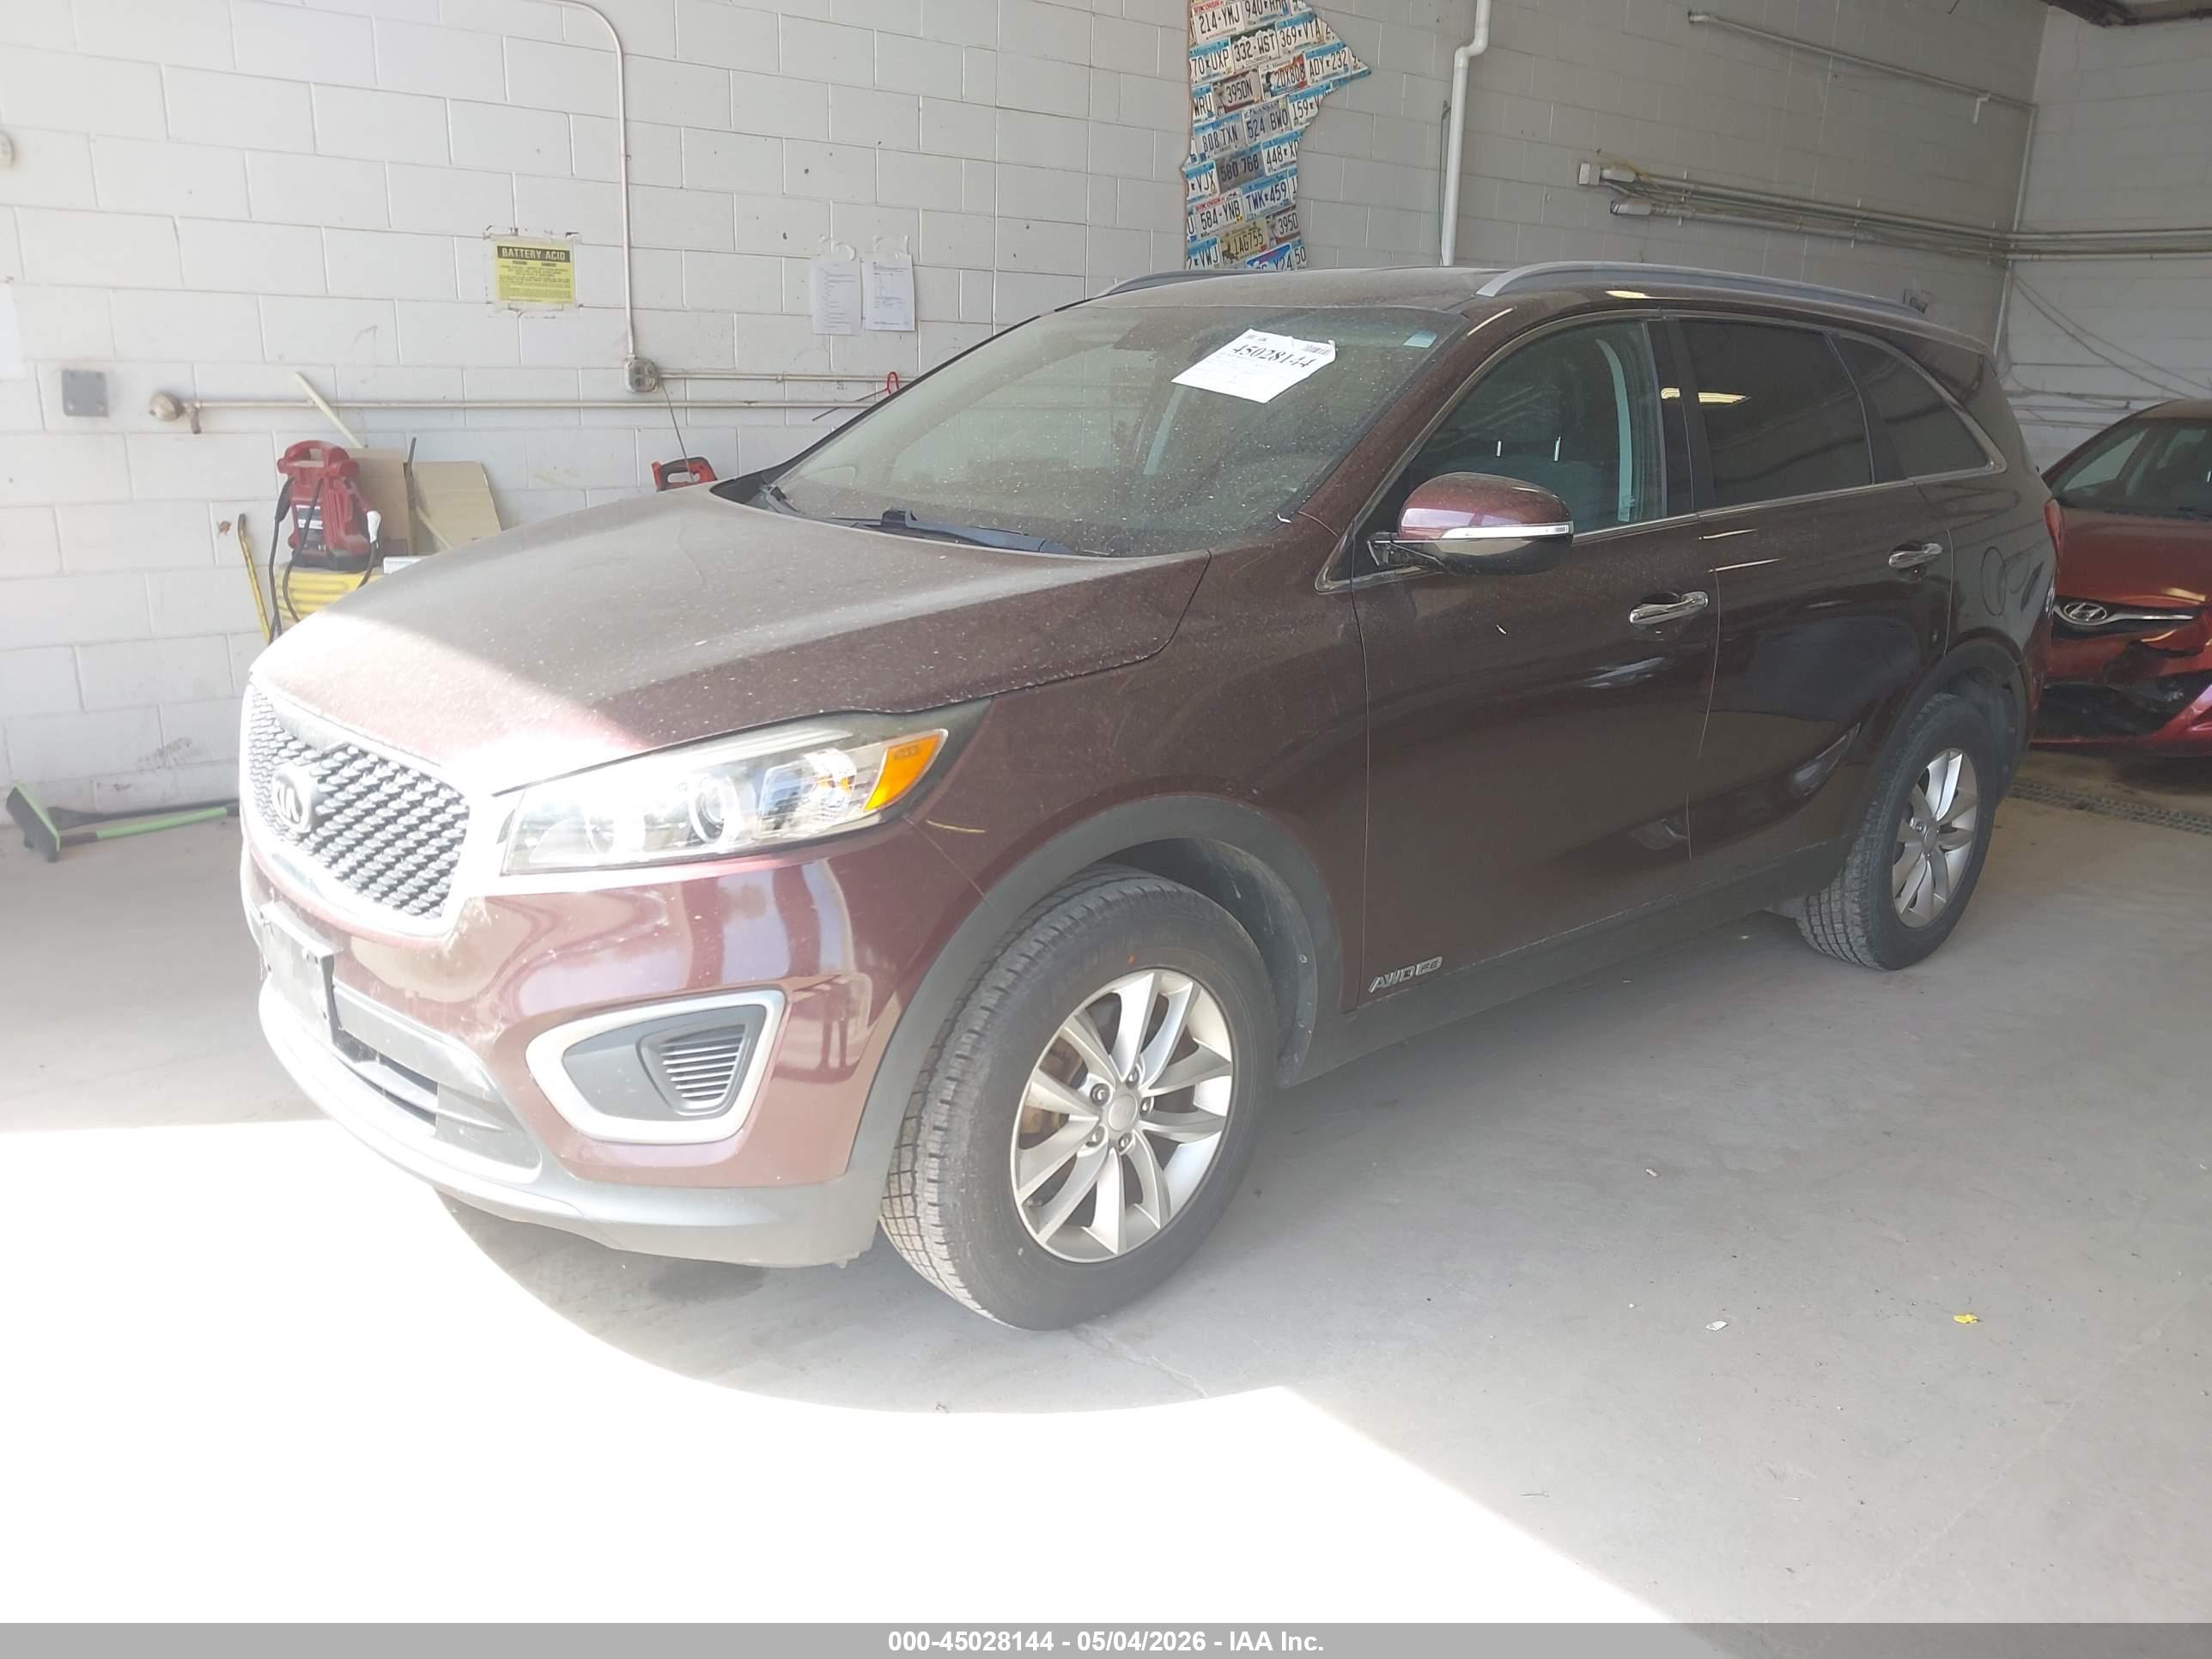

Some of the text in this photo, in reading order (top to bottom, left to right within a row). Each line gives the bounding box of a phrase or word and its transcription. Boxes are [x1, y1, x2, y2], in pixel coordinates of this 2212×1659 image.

[501, 247, 566, 261] BATTERY ACID
[1232, 344, 1316, 368] 45028144
[1368, 966, 1415, 994] AWD
